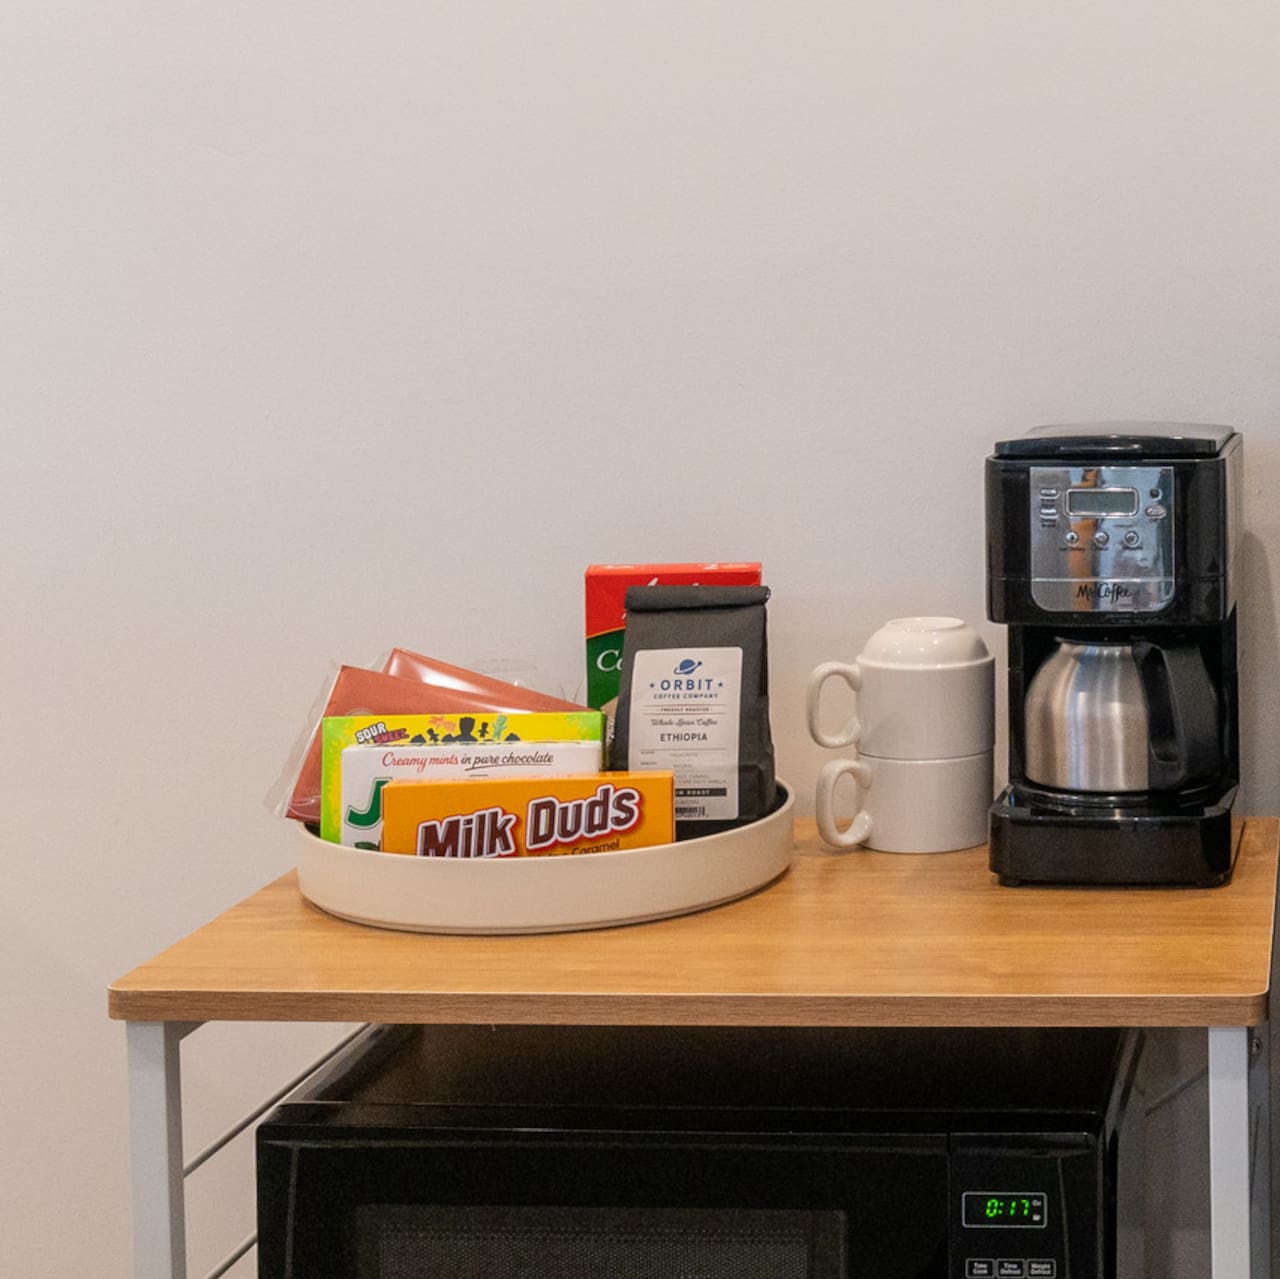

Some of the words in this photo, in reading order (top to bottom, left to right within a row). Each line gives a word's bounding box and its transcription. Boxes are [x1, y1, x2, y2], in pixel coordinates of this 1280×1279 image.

[1097, 582, 1132, 605] Coffee
[660, 679, 713, 690] ORBIT
[356, 721, 387, 743] SOUR
[660, 733, 708, 741] ETHIOPIA
[382, 751, 428, 773] Creamy
[428, 754, 458, 765] mints
[461, 752, 471, 764] in
[472, 755, 499, 768] pure
[501, 750, 554, 764] chocolate
[418, 808, 515, 858] Milk
[528, 785, 640, 850] Duds
[986, 1199, 1030, 1217] 0:17
